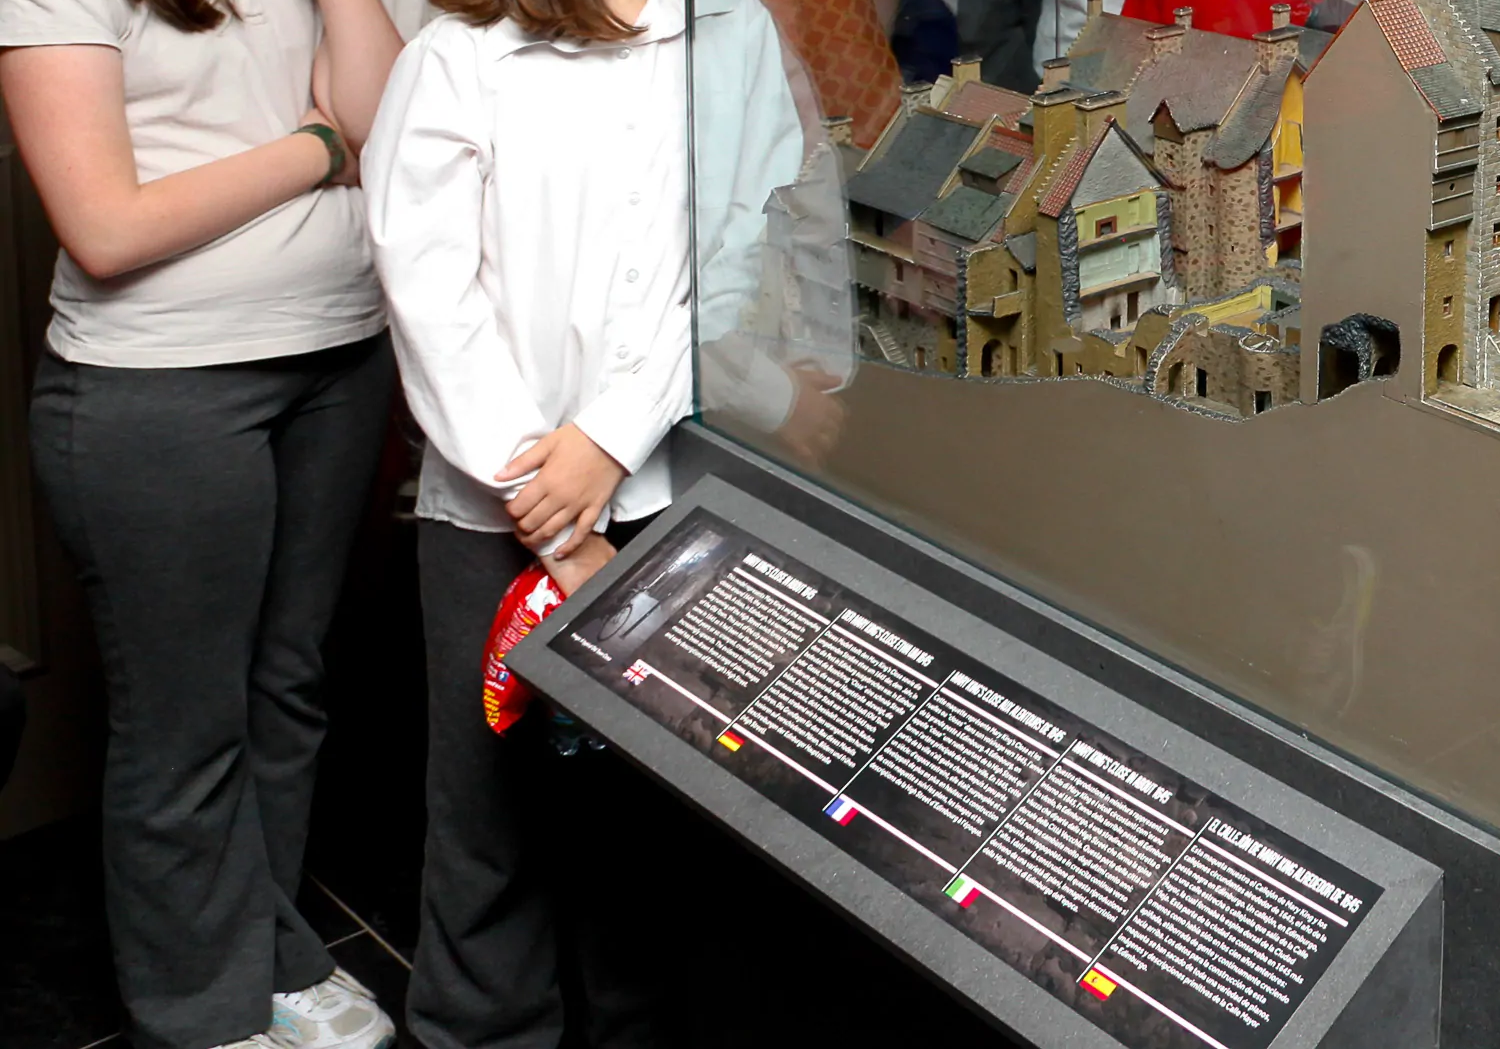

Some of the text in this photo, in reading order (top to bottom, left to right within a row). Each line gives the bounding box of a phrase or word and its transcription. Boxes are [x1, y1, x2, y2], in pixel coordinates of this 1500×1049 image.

[950, 671, 1067, 743] MARY KING'S CLOSE AUX ALENTOURS DE 1645
[1071, 740, 1173, 804] MARY KING'S CLOSE IN ABOUT 1645
[1174, 863, 1193, 877] peste
[1191, 872, 1209, 886] negra
[1214, 884, 1246, 909] Edimburgo.
[1253, 909, 1277, 928] callejón,
[1284, 926, 1318, 953] Edimburgo,
[1183, 854, 1211, 874] callejones
[1209, 870, 1246, 895] circundantes
[1243, 890, 1273, 910] alrededor
[1278, 910, 1296, 925] 1645,
[1300, 924, 1313, 935] año
[1190, 844, 1205, 857] Esta
[1202, 853, 1228, 871] maqueta
[1226, 867, 1251, 884] muestra
[1254, 882, 1279, 901] Callejón
[1284, 900, 1301, 915] Mary
[1299, 908, 1315, 923] King
[1316, 918, 1328, 930] los
[1207, 818, 1363, 913] EL CALLEJÓN DE MARY KING ALREDEDOR DE 1645
[1117, 946, 1148, 972] Edimburgo.
[1117, 933, 1145, 955] imágenes
[1147, 953, 1186, 981] descripciones
[1182, 977, 1214, 999] primitivas
[1225, 1002, 1242, 1017] Calle
[1239, 1011, 1260, 1028] Mayor
[1124, 925, 1150, 944] maqueta
[1154, 943, 1168, 955] han
[1165, 951, 1187, 967] sacado
[1192, 967, 1208, 981] toda
[1205, 976, 1218, 988] una
[1216, 983, 1244, 1003] variedad
[1247, 1004, 1270, 1022] planos,
[1139, 907, 1163, 926] apiñada,
[1161, 921, 1192, 943] atiborrada
[1196, 943, 1215, 957] gente
[1217, 956, 1261, 986] continuamente
[1259, 982, 1290, 1004] creciendo
